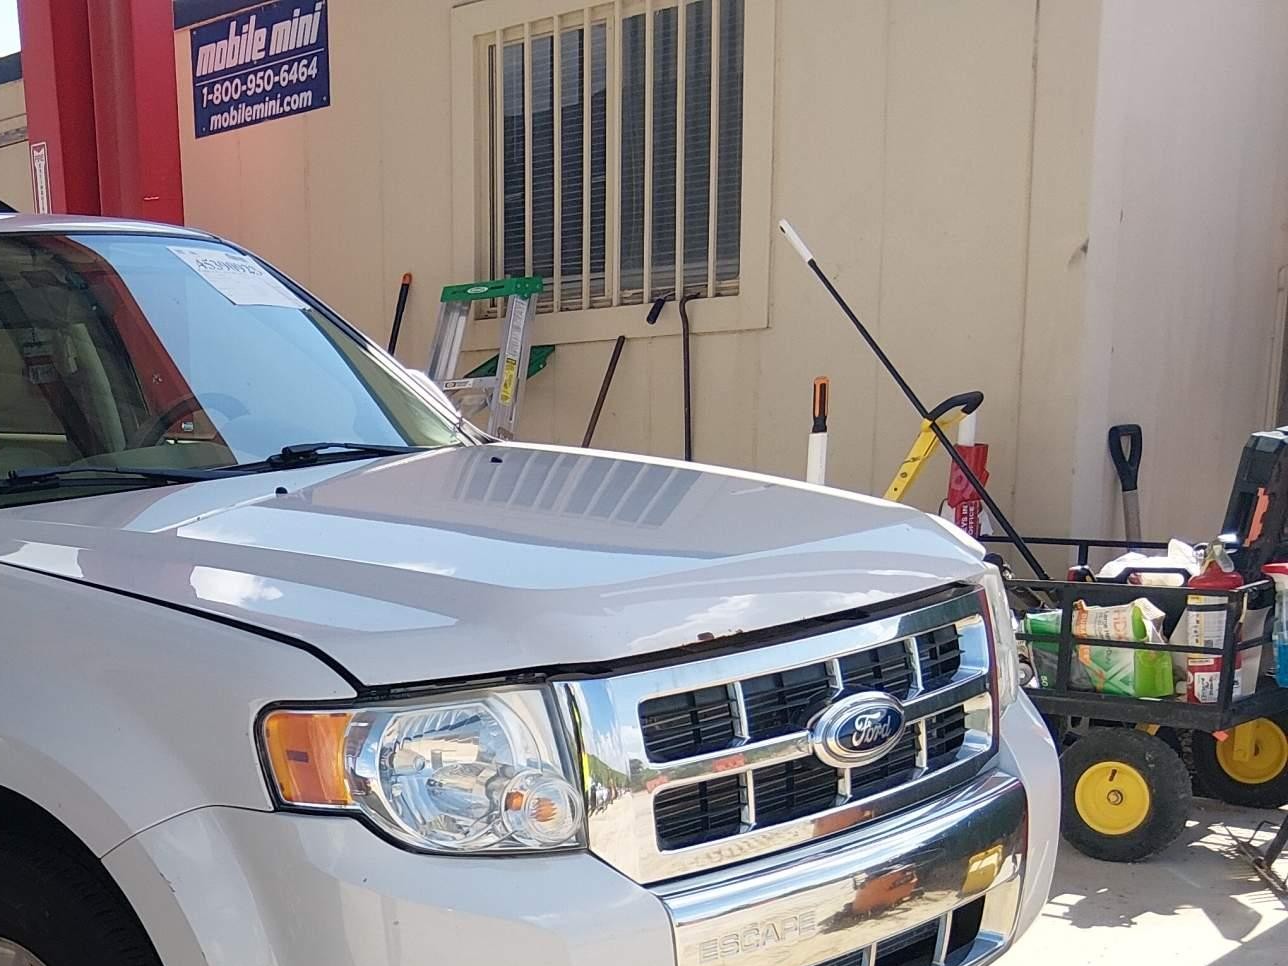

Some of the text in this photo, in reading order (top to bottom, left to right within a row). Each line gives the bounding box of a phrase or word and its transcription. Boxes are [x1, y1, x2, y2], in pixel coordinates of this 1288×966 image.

[196, 2, 322, 77] mobile mini
[202, 56, 318, 108] 1-800-950-6464
[210, 90, 312, 131] mobilemini.com
[852, 711, 892, 747] Ford
[698, 911, 817, 963] ESCAPE
